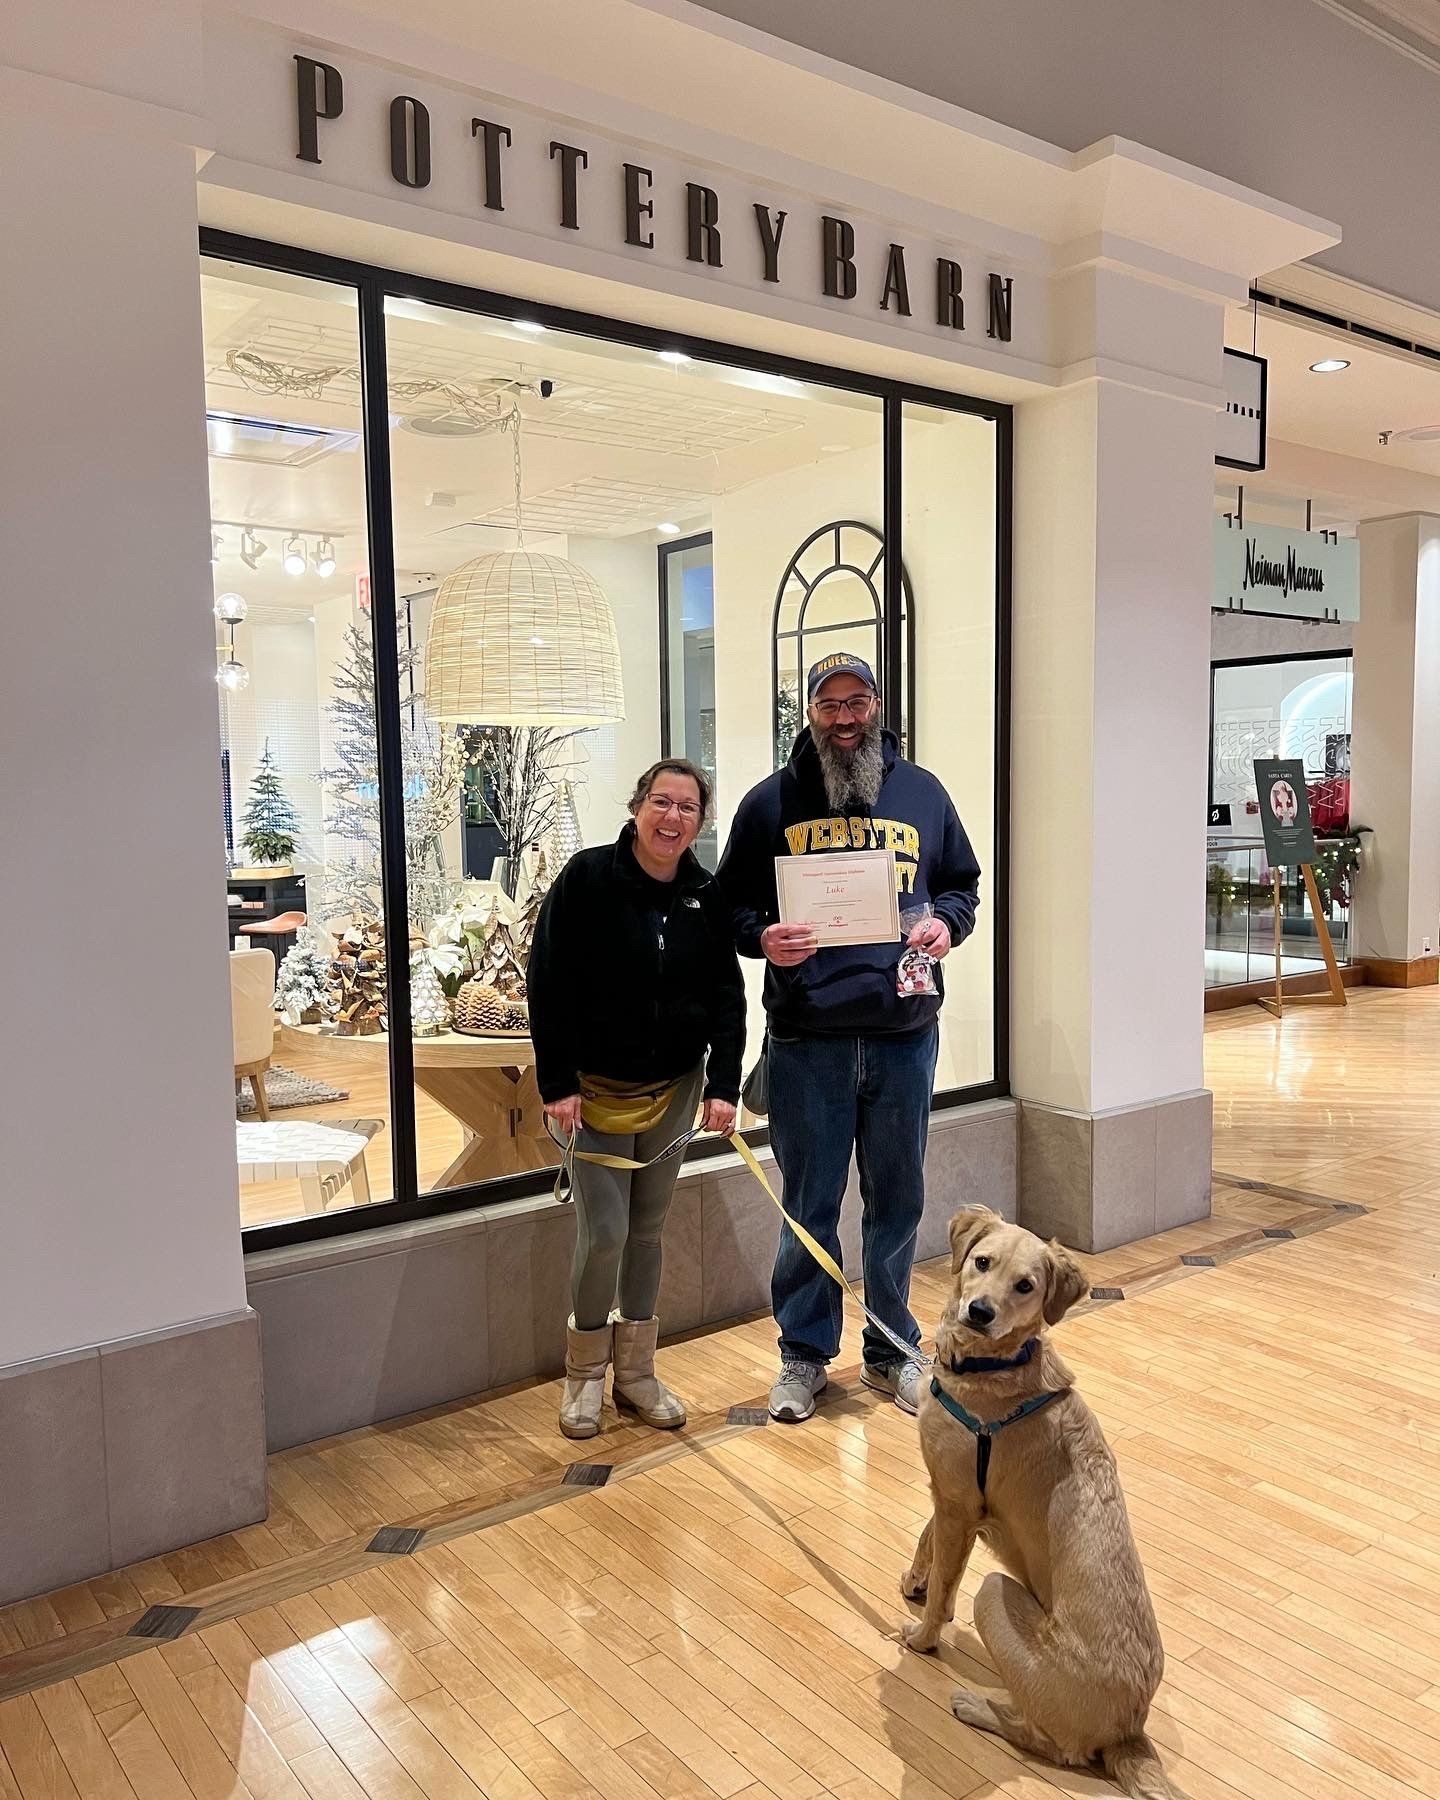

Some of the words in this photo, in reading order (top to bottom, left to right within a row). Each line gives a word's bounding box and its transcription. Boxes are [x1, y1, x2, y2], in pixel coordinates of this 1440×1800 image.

[1243, 538, 1285, 590] Neiman
[1283, 545, 1324, 598] Marcus
[816, 655, 849, 675] BLUES
[785, 816, 919, 861] WEBSTER
[826, 885, 845, 894] Luke
[895, 861, 918, 893] TY
